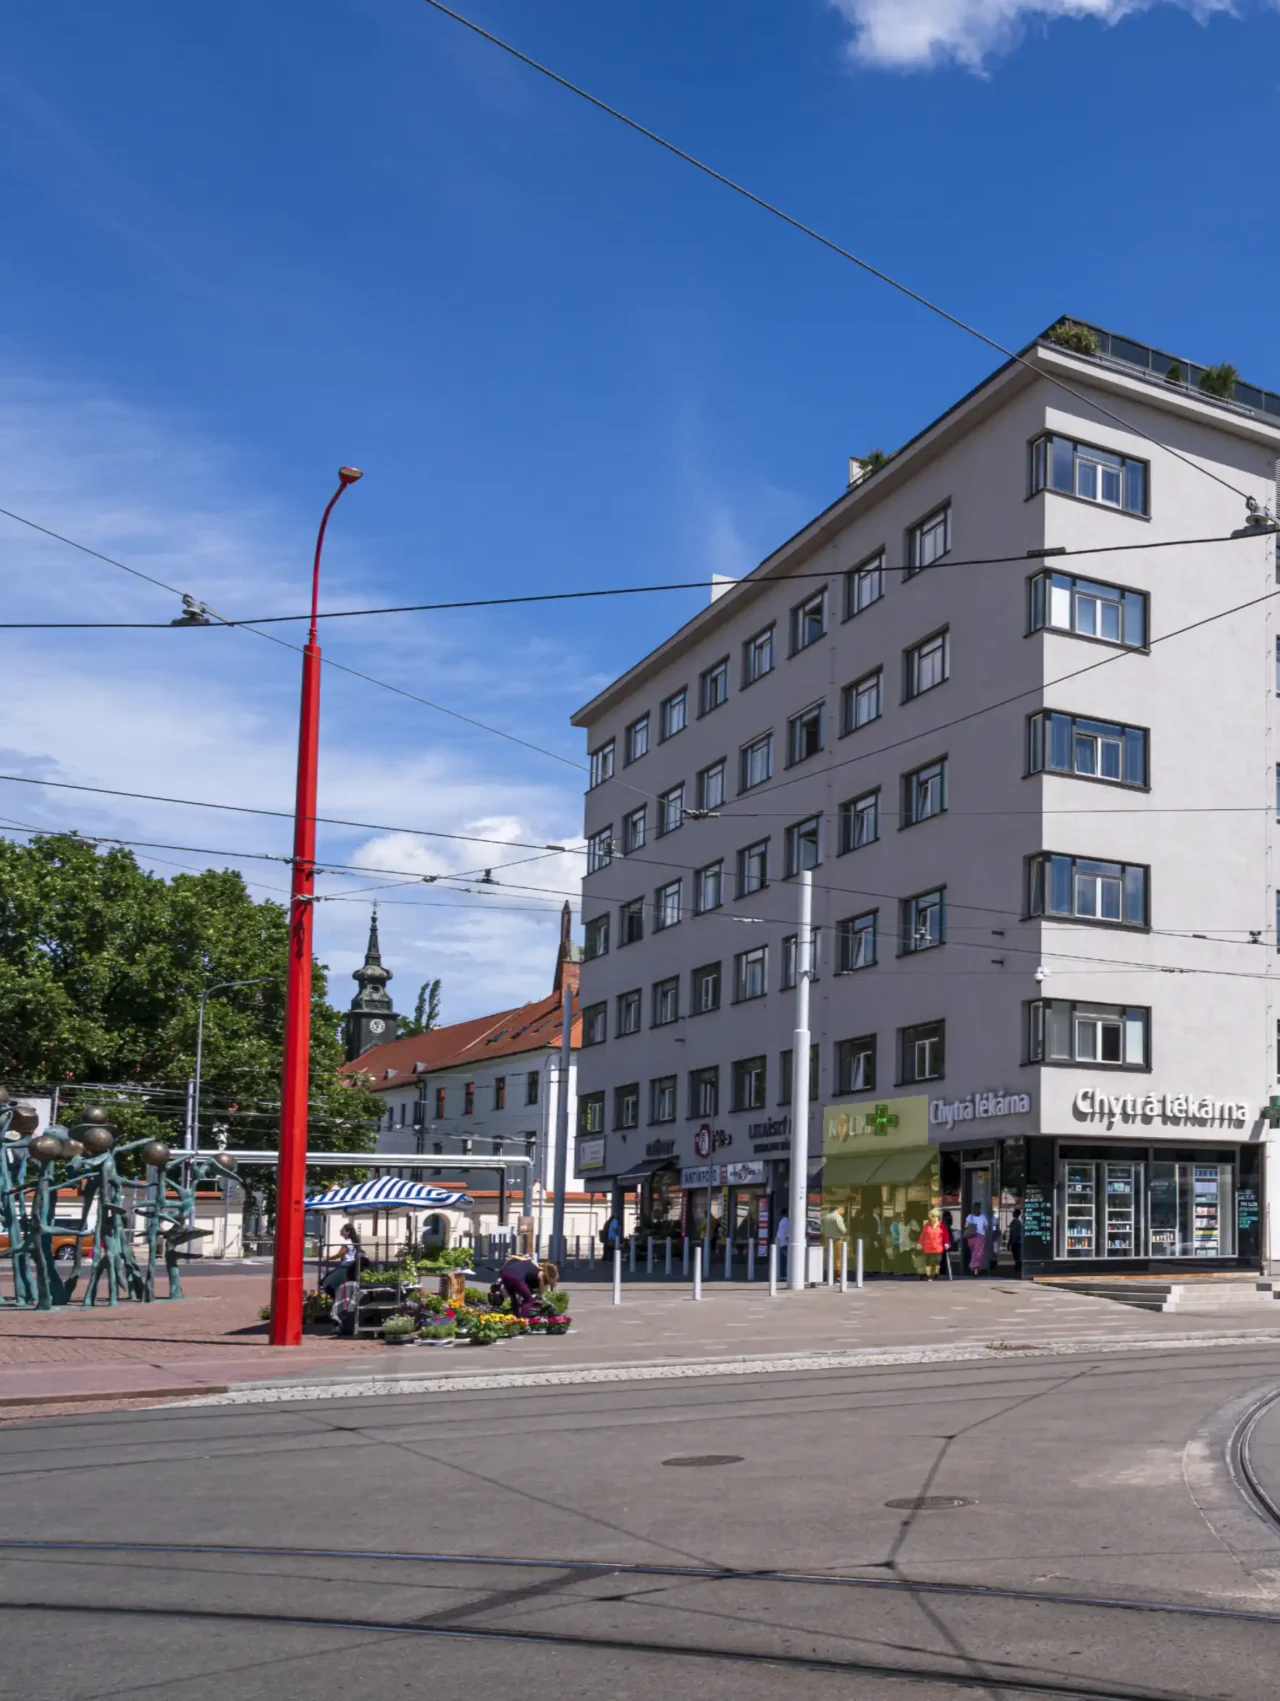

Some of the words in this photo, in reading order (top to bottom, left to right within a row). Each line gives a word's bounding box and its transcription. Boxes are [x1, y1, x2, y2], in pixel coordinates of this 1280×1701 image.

[929, 1094, 974, 1130] Chytrá
[975, 1090, 1031, 1118] lékárna
[1076, 1087, 1157, 1122] Chytrá
[1163, 1092, 1249, 1121] lékárna
